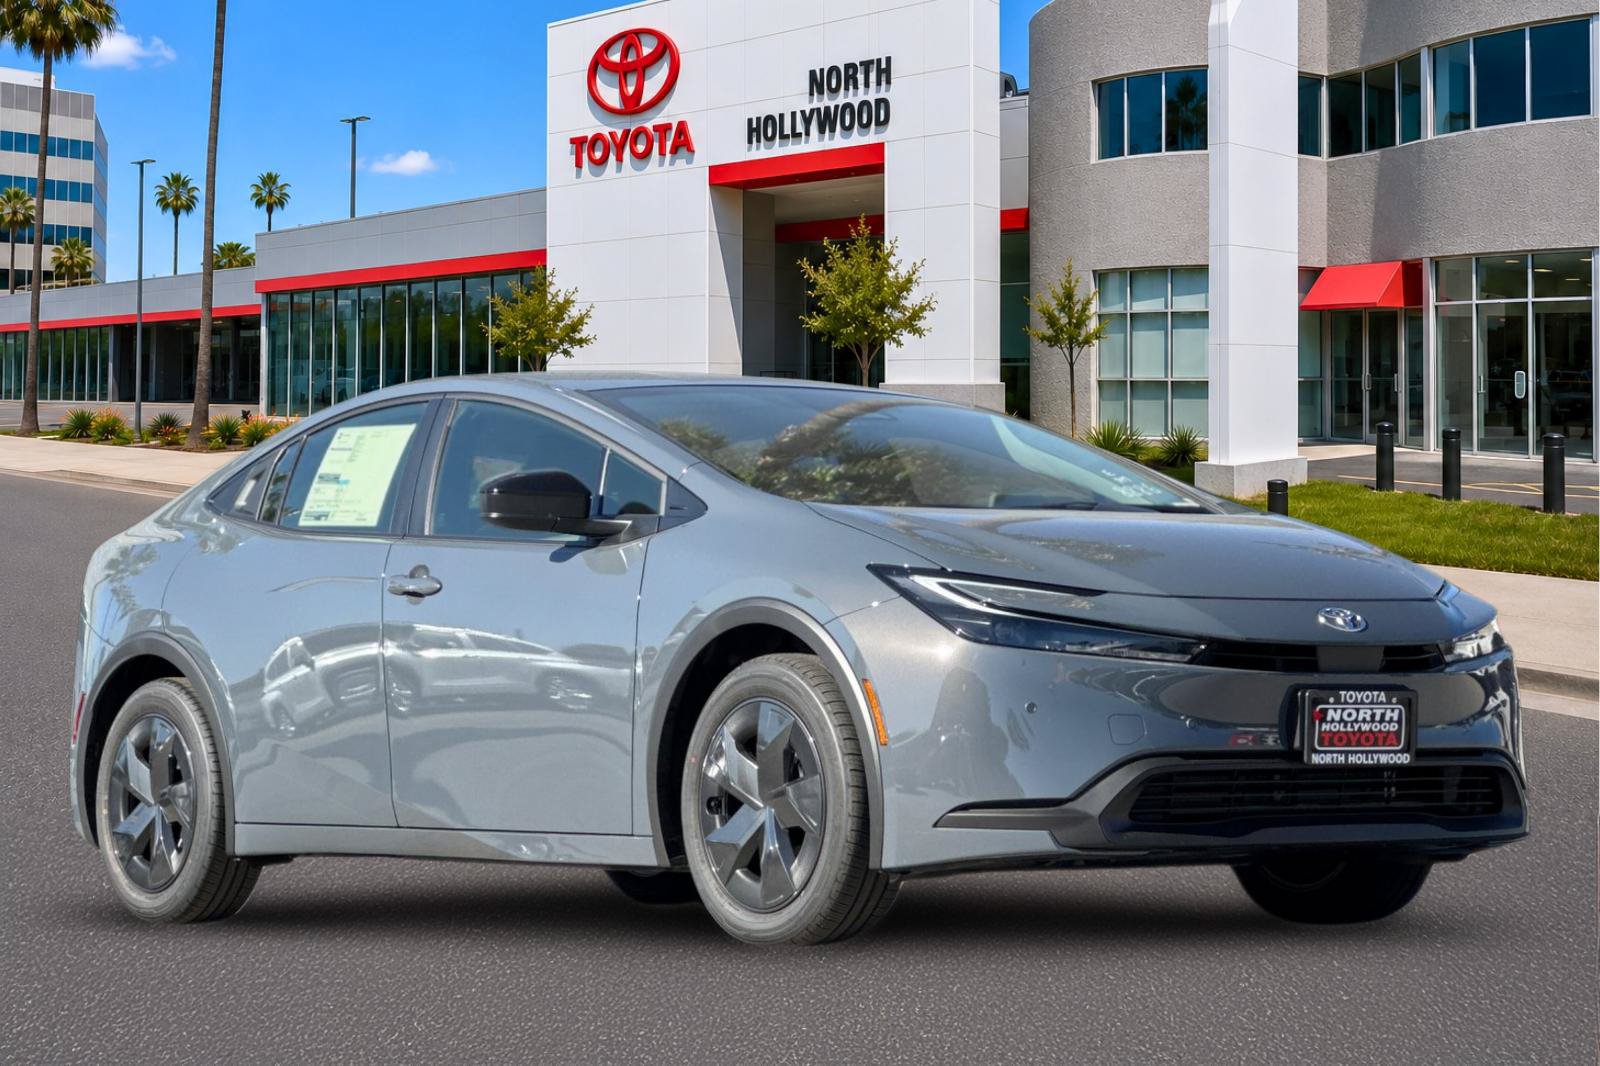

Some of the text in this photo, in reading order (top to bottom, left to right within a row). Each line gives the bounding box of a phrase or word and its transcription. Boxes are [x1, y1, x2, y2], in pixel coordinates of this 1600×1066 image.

[809, 56, 892, 97] NORTH
[747, 98, 891, 145] HOLLYWOOD
[569, 120, 695, 169] TOYOTA
[1339, 691, 1387, 703] TOYOTA
[1326, 708, 1400, 721] NORTH
[1321, 722, 1398, 731] HOLLYWOOD
[1321, 732, 1398, 746] TOYOTA
[1311, 753, 1410, 764] NORTH HOLLYWOOD
